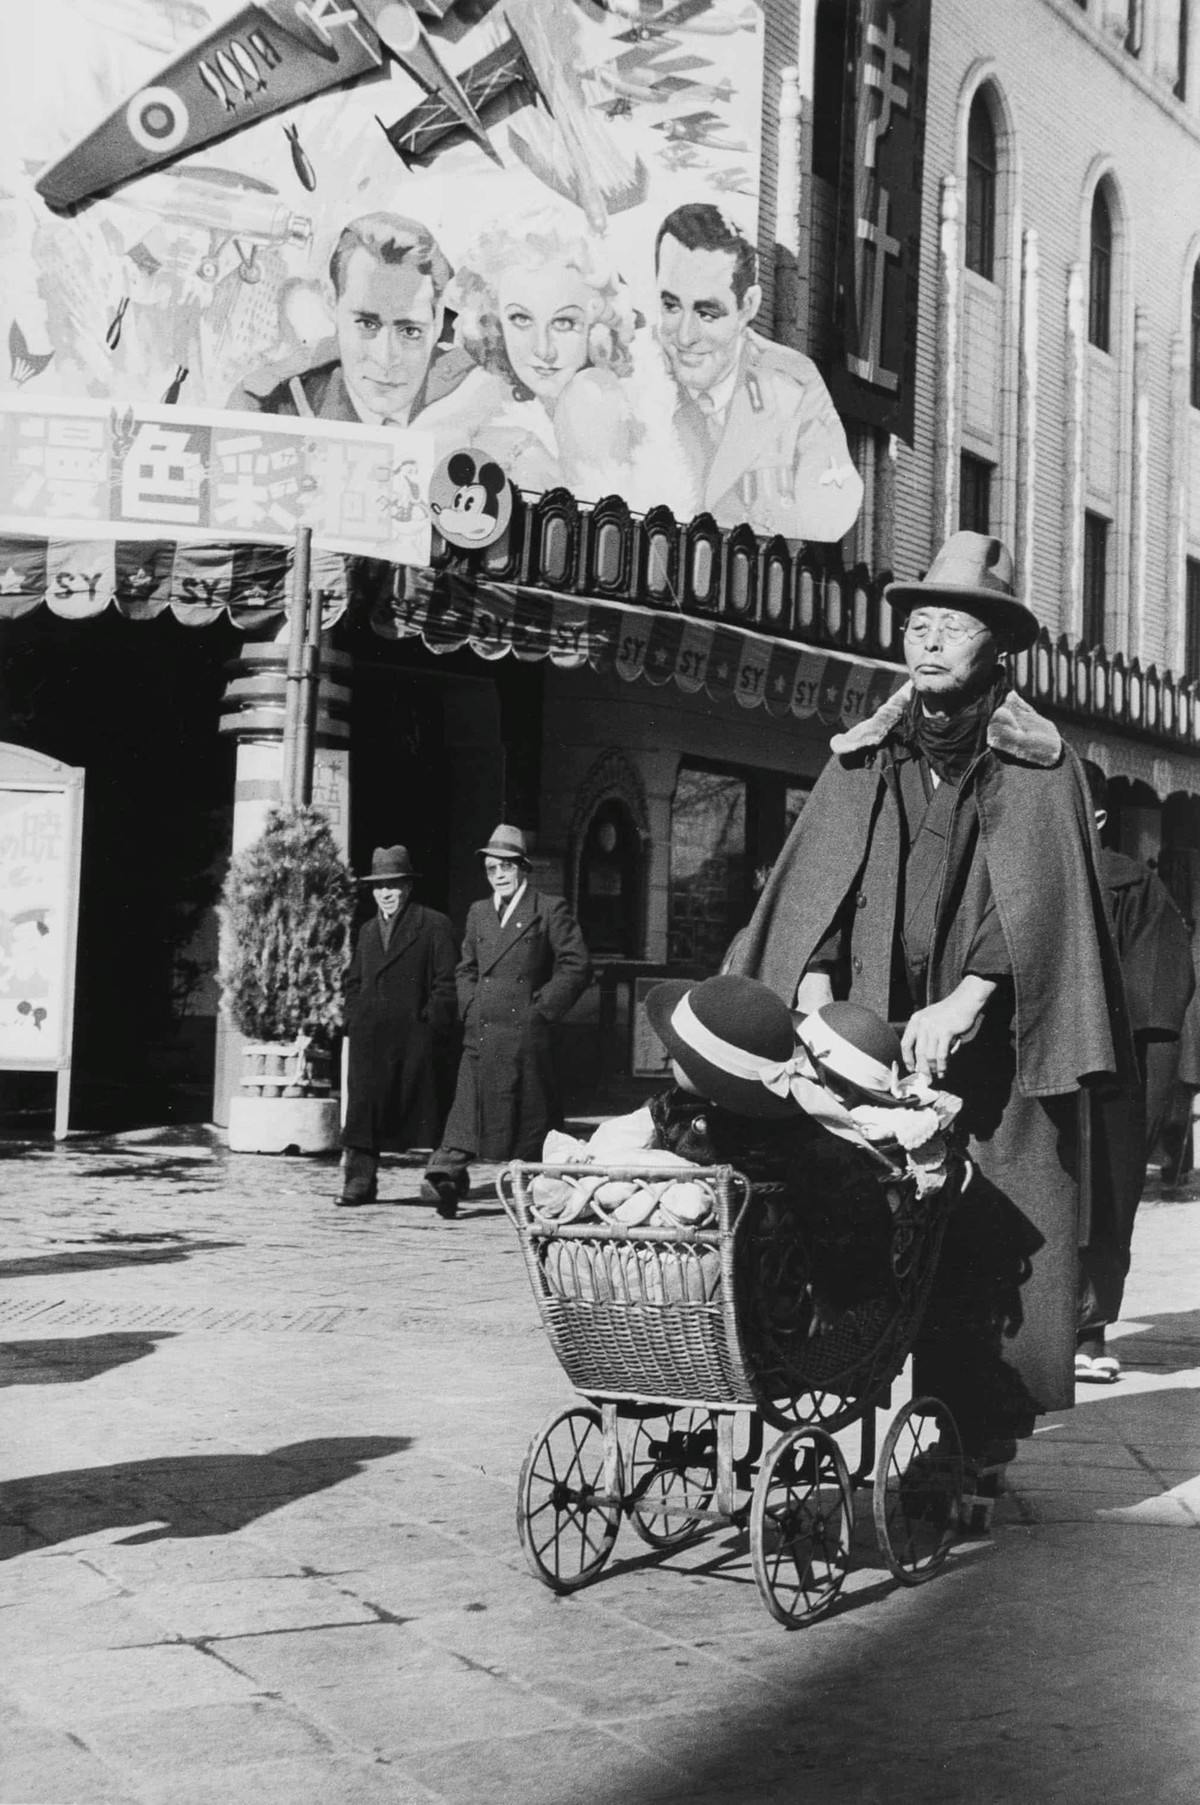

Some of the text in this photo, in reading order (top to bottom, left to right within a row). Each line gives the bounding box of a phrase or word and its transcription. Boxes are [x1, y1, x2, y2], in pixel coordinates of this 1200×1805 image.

[54, 572, 102, 601] SY
[180, 577, 221, 607] SY
[620, 636, 646, 664] SY
[680, 650, 707, 677] SY
[741, 665, 764, 693] SY
[795, 681, 818, 706] SY
[844, 689, 865, 715] SY
